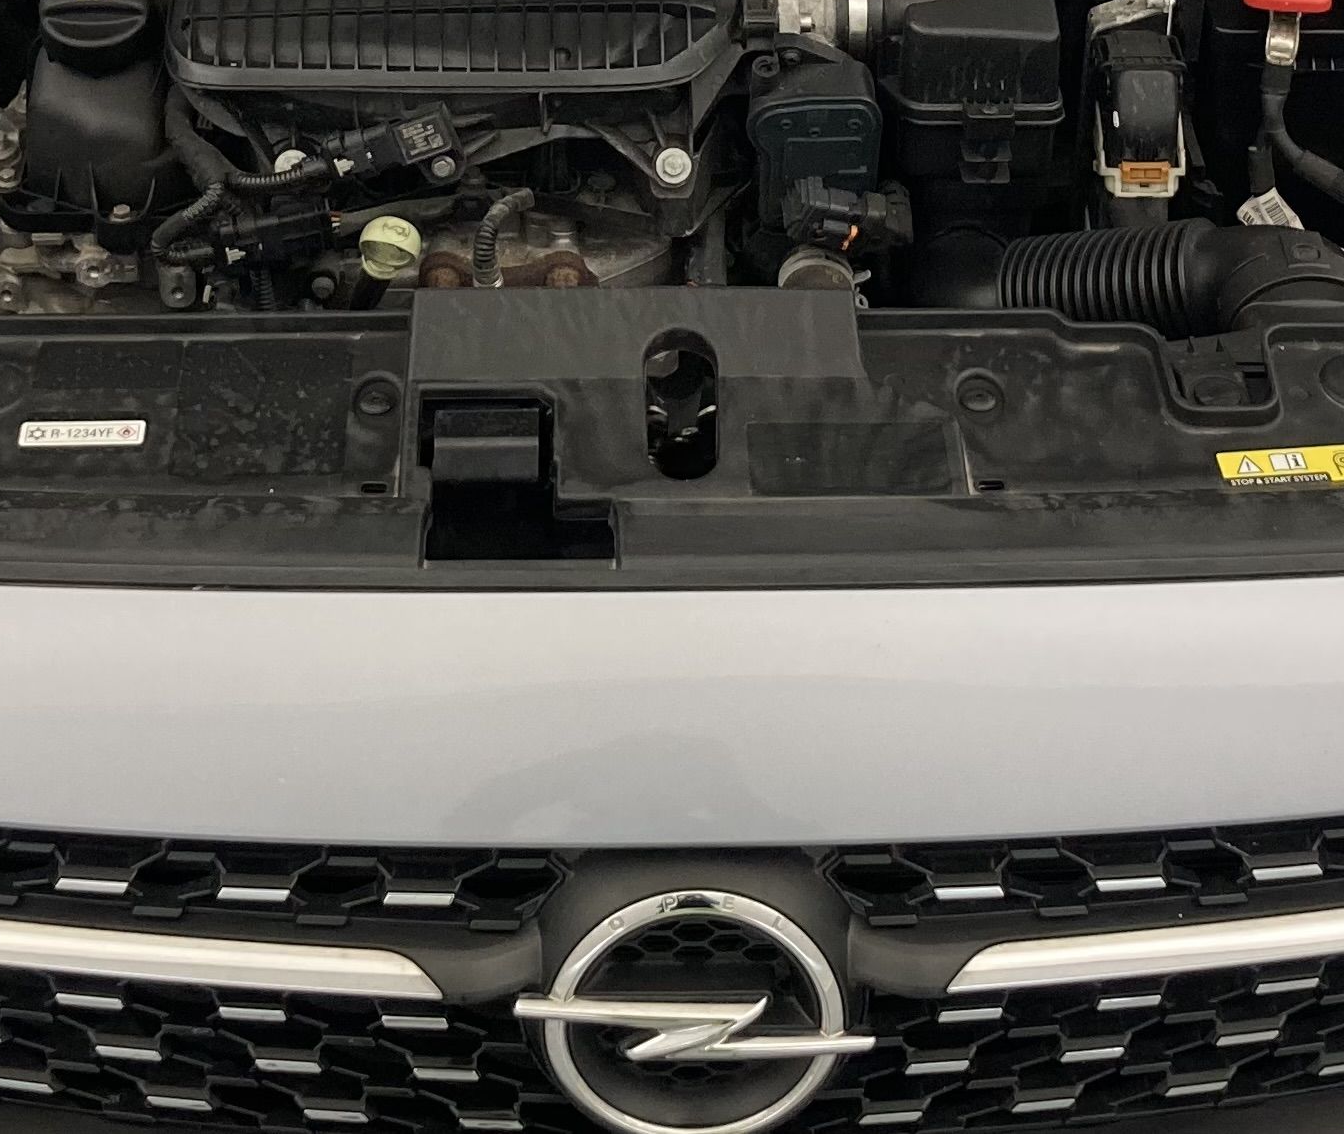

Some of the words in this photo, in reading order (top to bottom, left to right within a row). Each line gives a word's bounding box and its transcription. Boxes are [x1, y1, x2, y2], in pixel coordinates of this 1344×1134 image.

[50, 428, 113, 438] R-1234YF
[1231, 478, 1255, 486] STOP
[1264, 476, 1291, 484] START
[1294, 473, 1328, 482] SYSTEM
[607, 893, 788, 931] OPEL
